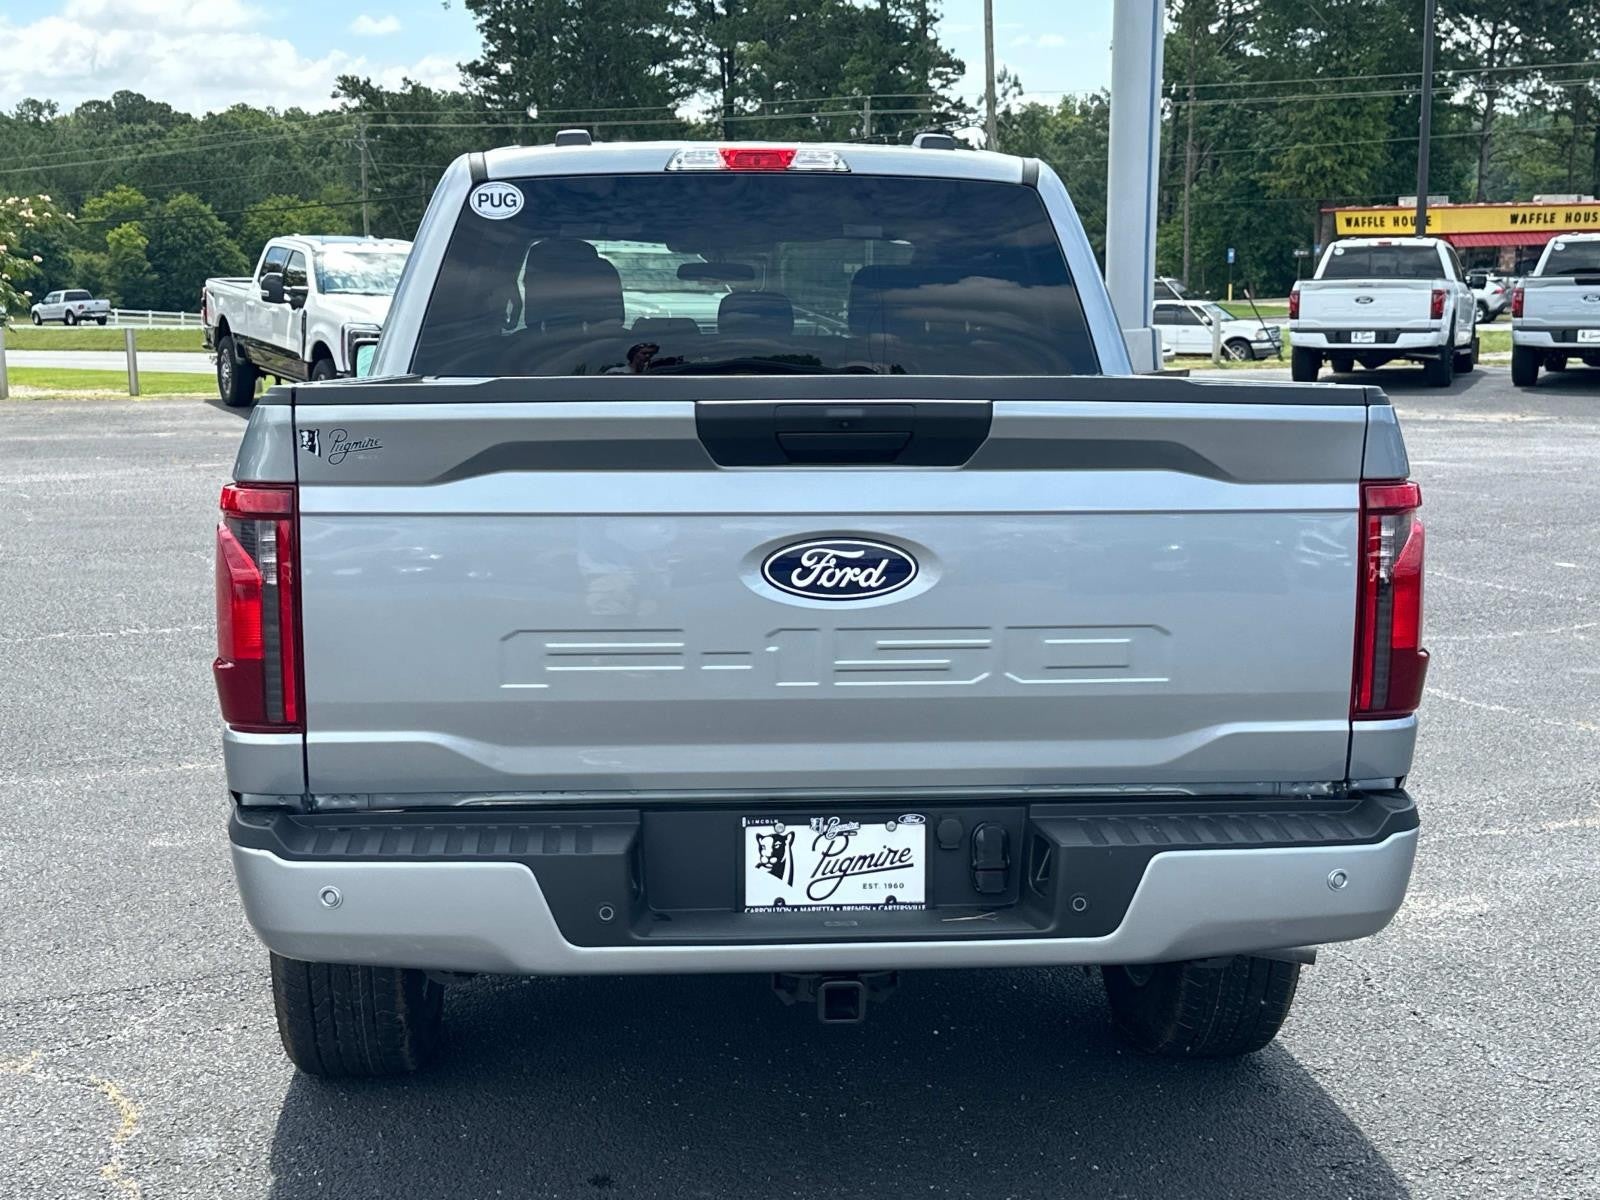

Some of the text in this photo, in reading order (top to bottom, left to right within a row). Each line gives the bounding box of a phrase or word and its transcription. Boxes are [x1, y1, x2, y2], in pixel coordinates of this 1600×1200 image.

[477, 192, 517, 208] PUG
[1510, 212, 1556, 224] WAFFLE
[1345, 215, 1432, 227] WAFFLE HOUE
[328, 428, 384, 465] Pugmire
[790, 546, 887, 589] Ford
[500, 625, 1171, 689] F-150
[806, 834, 914, 901] Pugmire
